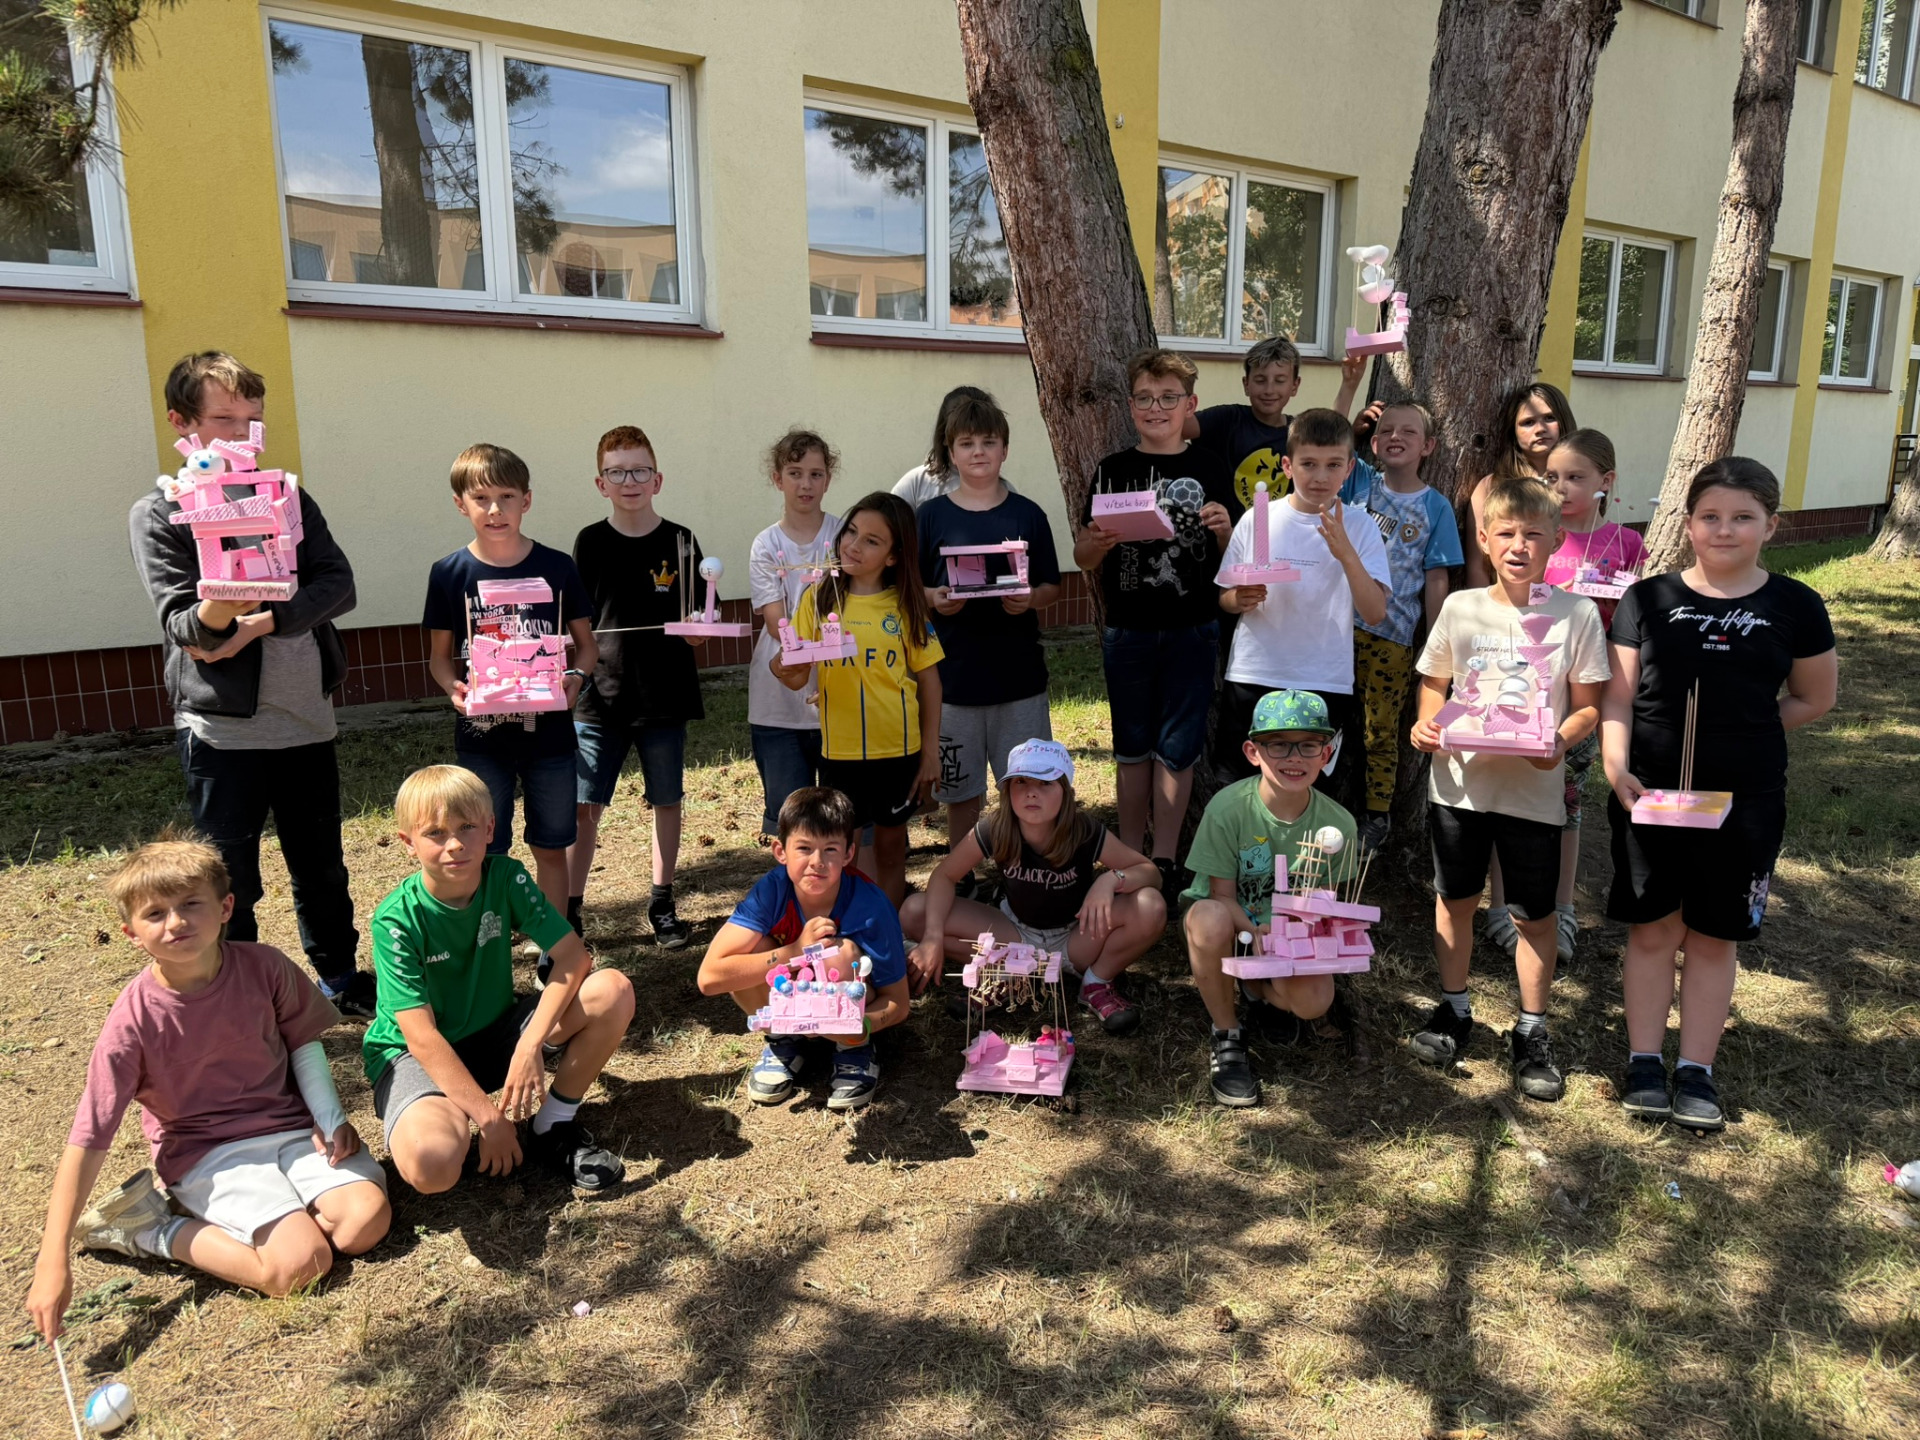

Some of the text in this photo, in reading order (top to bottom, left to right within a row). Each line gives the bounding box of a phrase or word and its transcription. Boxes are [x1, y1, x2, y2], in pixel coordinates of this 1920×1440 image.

[483, 607, 505, 617] YORK
[501, 619, 553, 636] BROOKLYN
[1669, 606, 1772, 636] Tommy Hilfiger
[426, 951, 450, 963] JAKO
